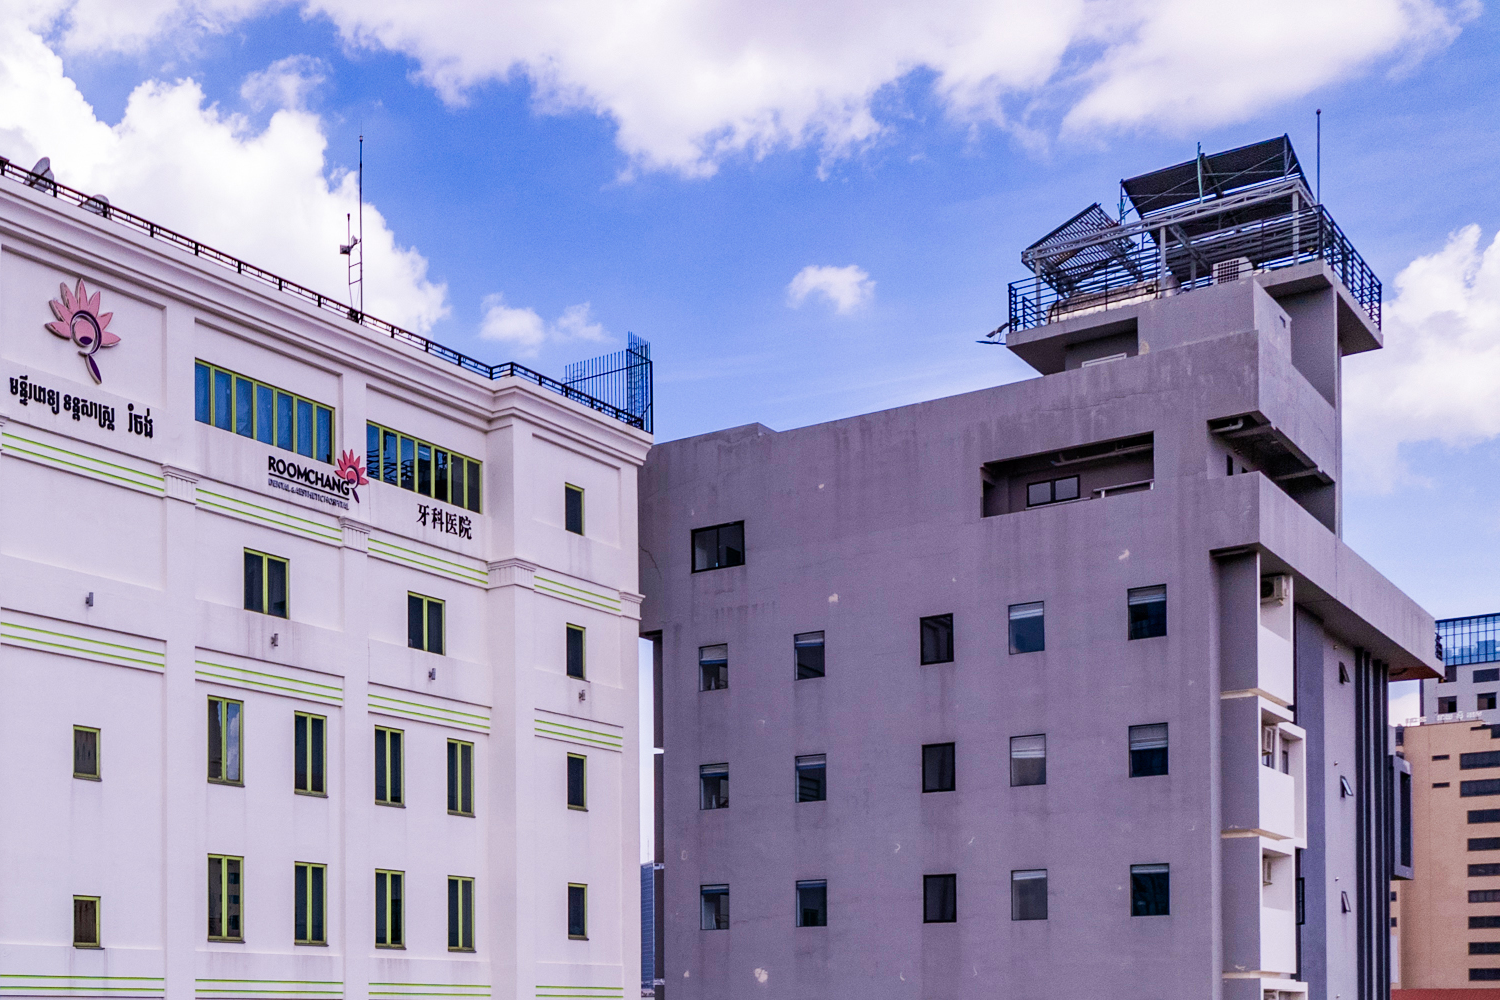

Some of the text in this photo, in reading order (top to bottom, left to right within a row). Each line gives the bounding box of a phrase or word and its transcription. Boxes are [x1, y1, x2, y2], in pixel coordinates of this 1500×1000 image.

[268, 455, 349, 495] ROOMCHANG
[416, 503, 472, 540] 牙科医院
